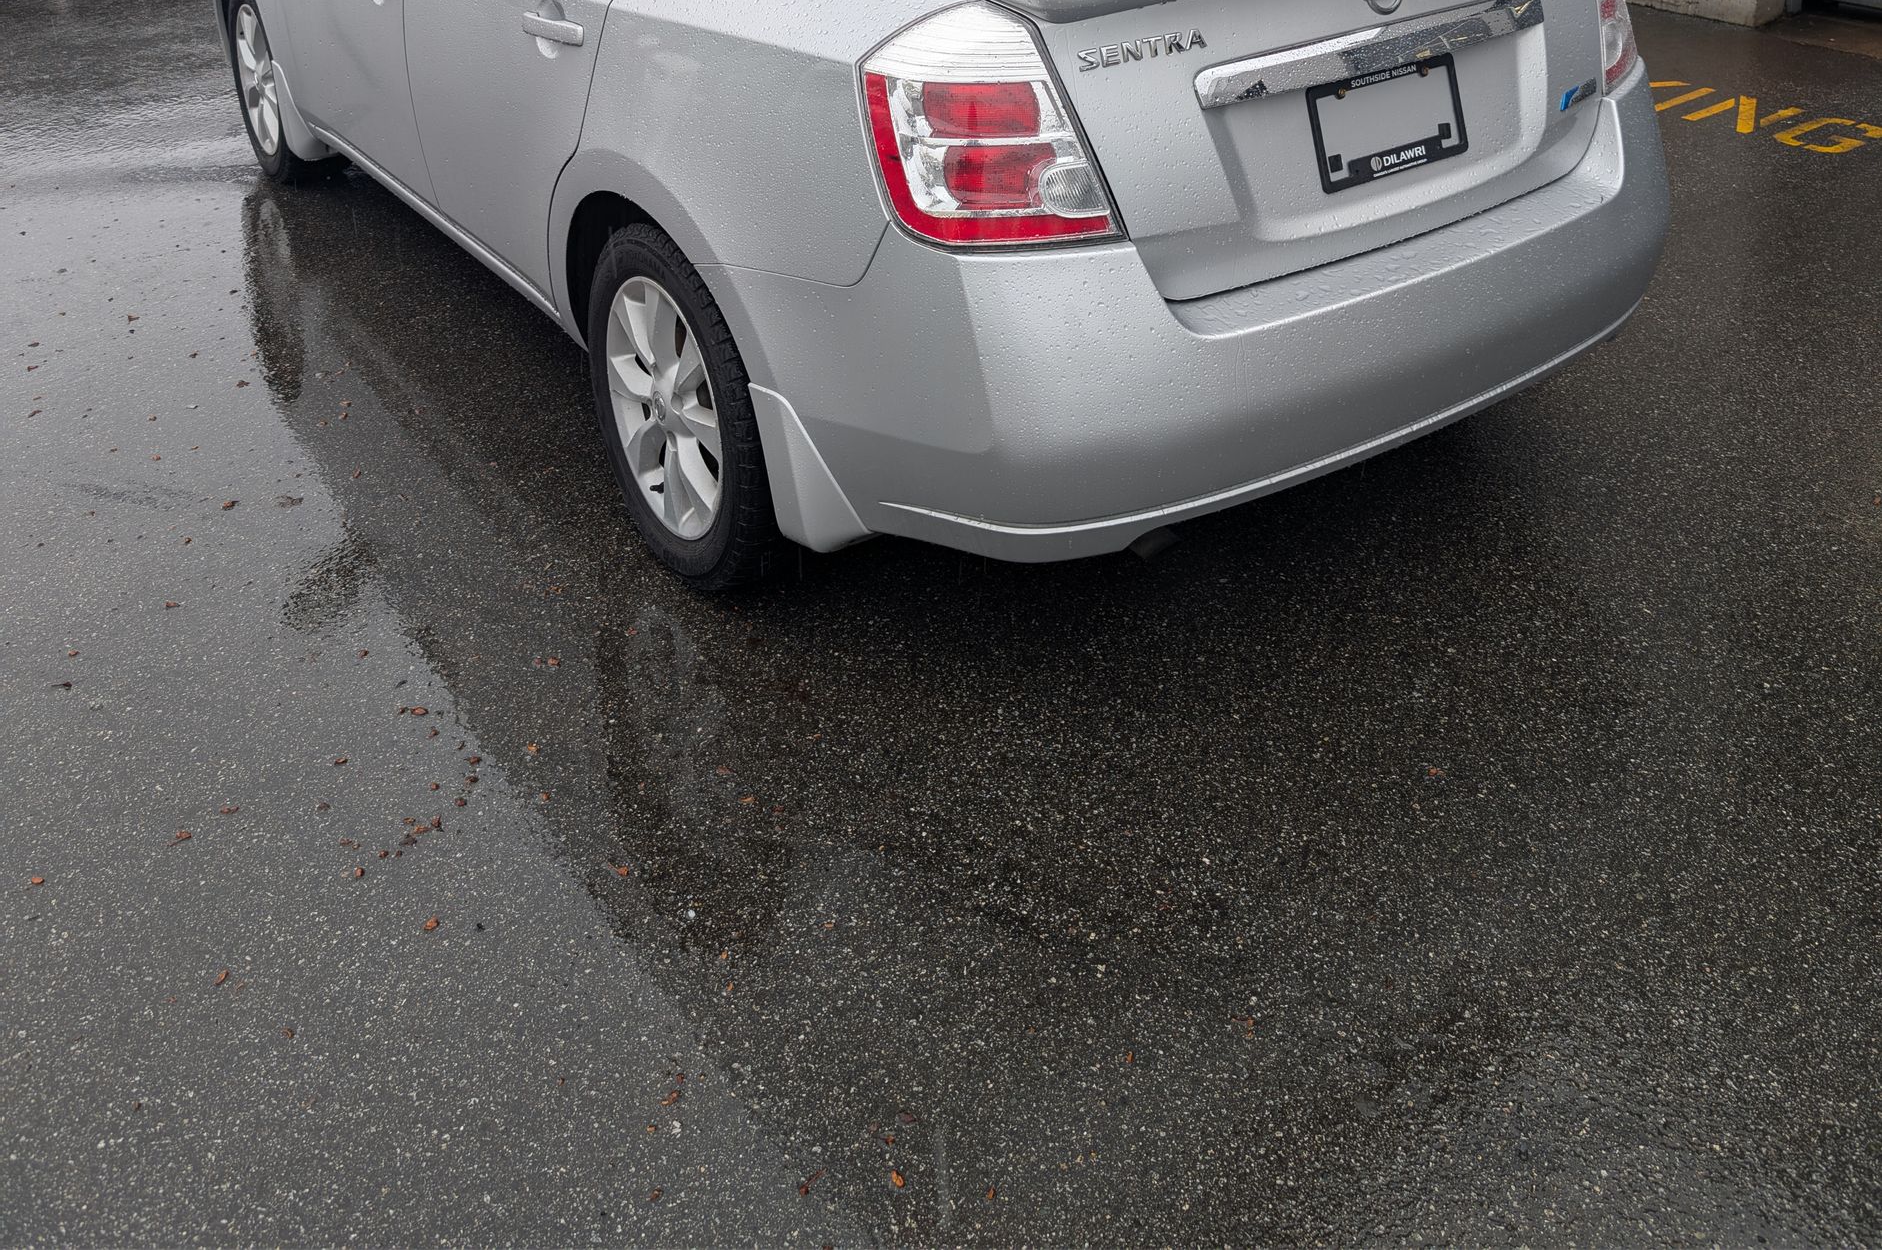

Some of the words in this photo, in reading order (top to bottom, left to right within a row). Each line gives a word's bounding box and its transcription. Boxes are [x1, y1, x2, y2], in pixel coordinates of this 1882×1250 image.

[1077, 29, 1208, 72] SENTRA
[1350, 71, 1391, 88] SOUTHSIDE
[1391, 64, 1417, 77] NISSAN
[1650, 81, 1882, 153] ING
[1382, 145, 1426, 166] DILAWRI
